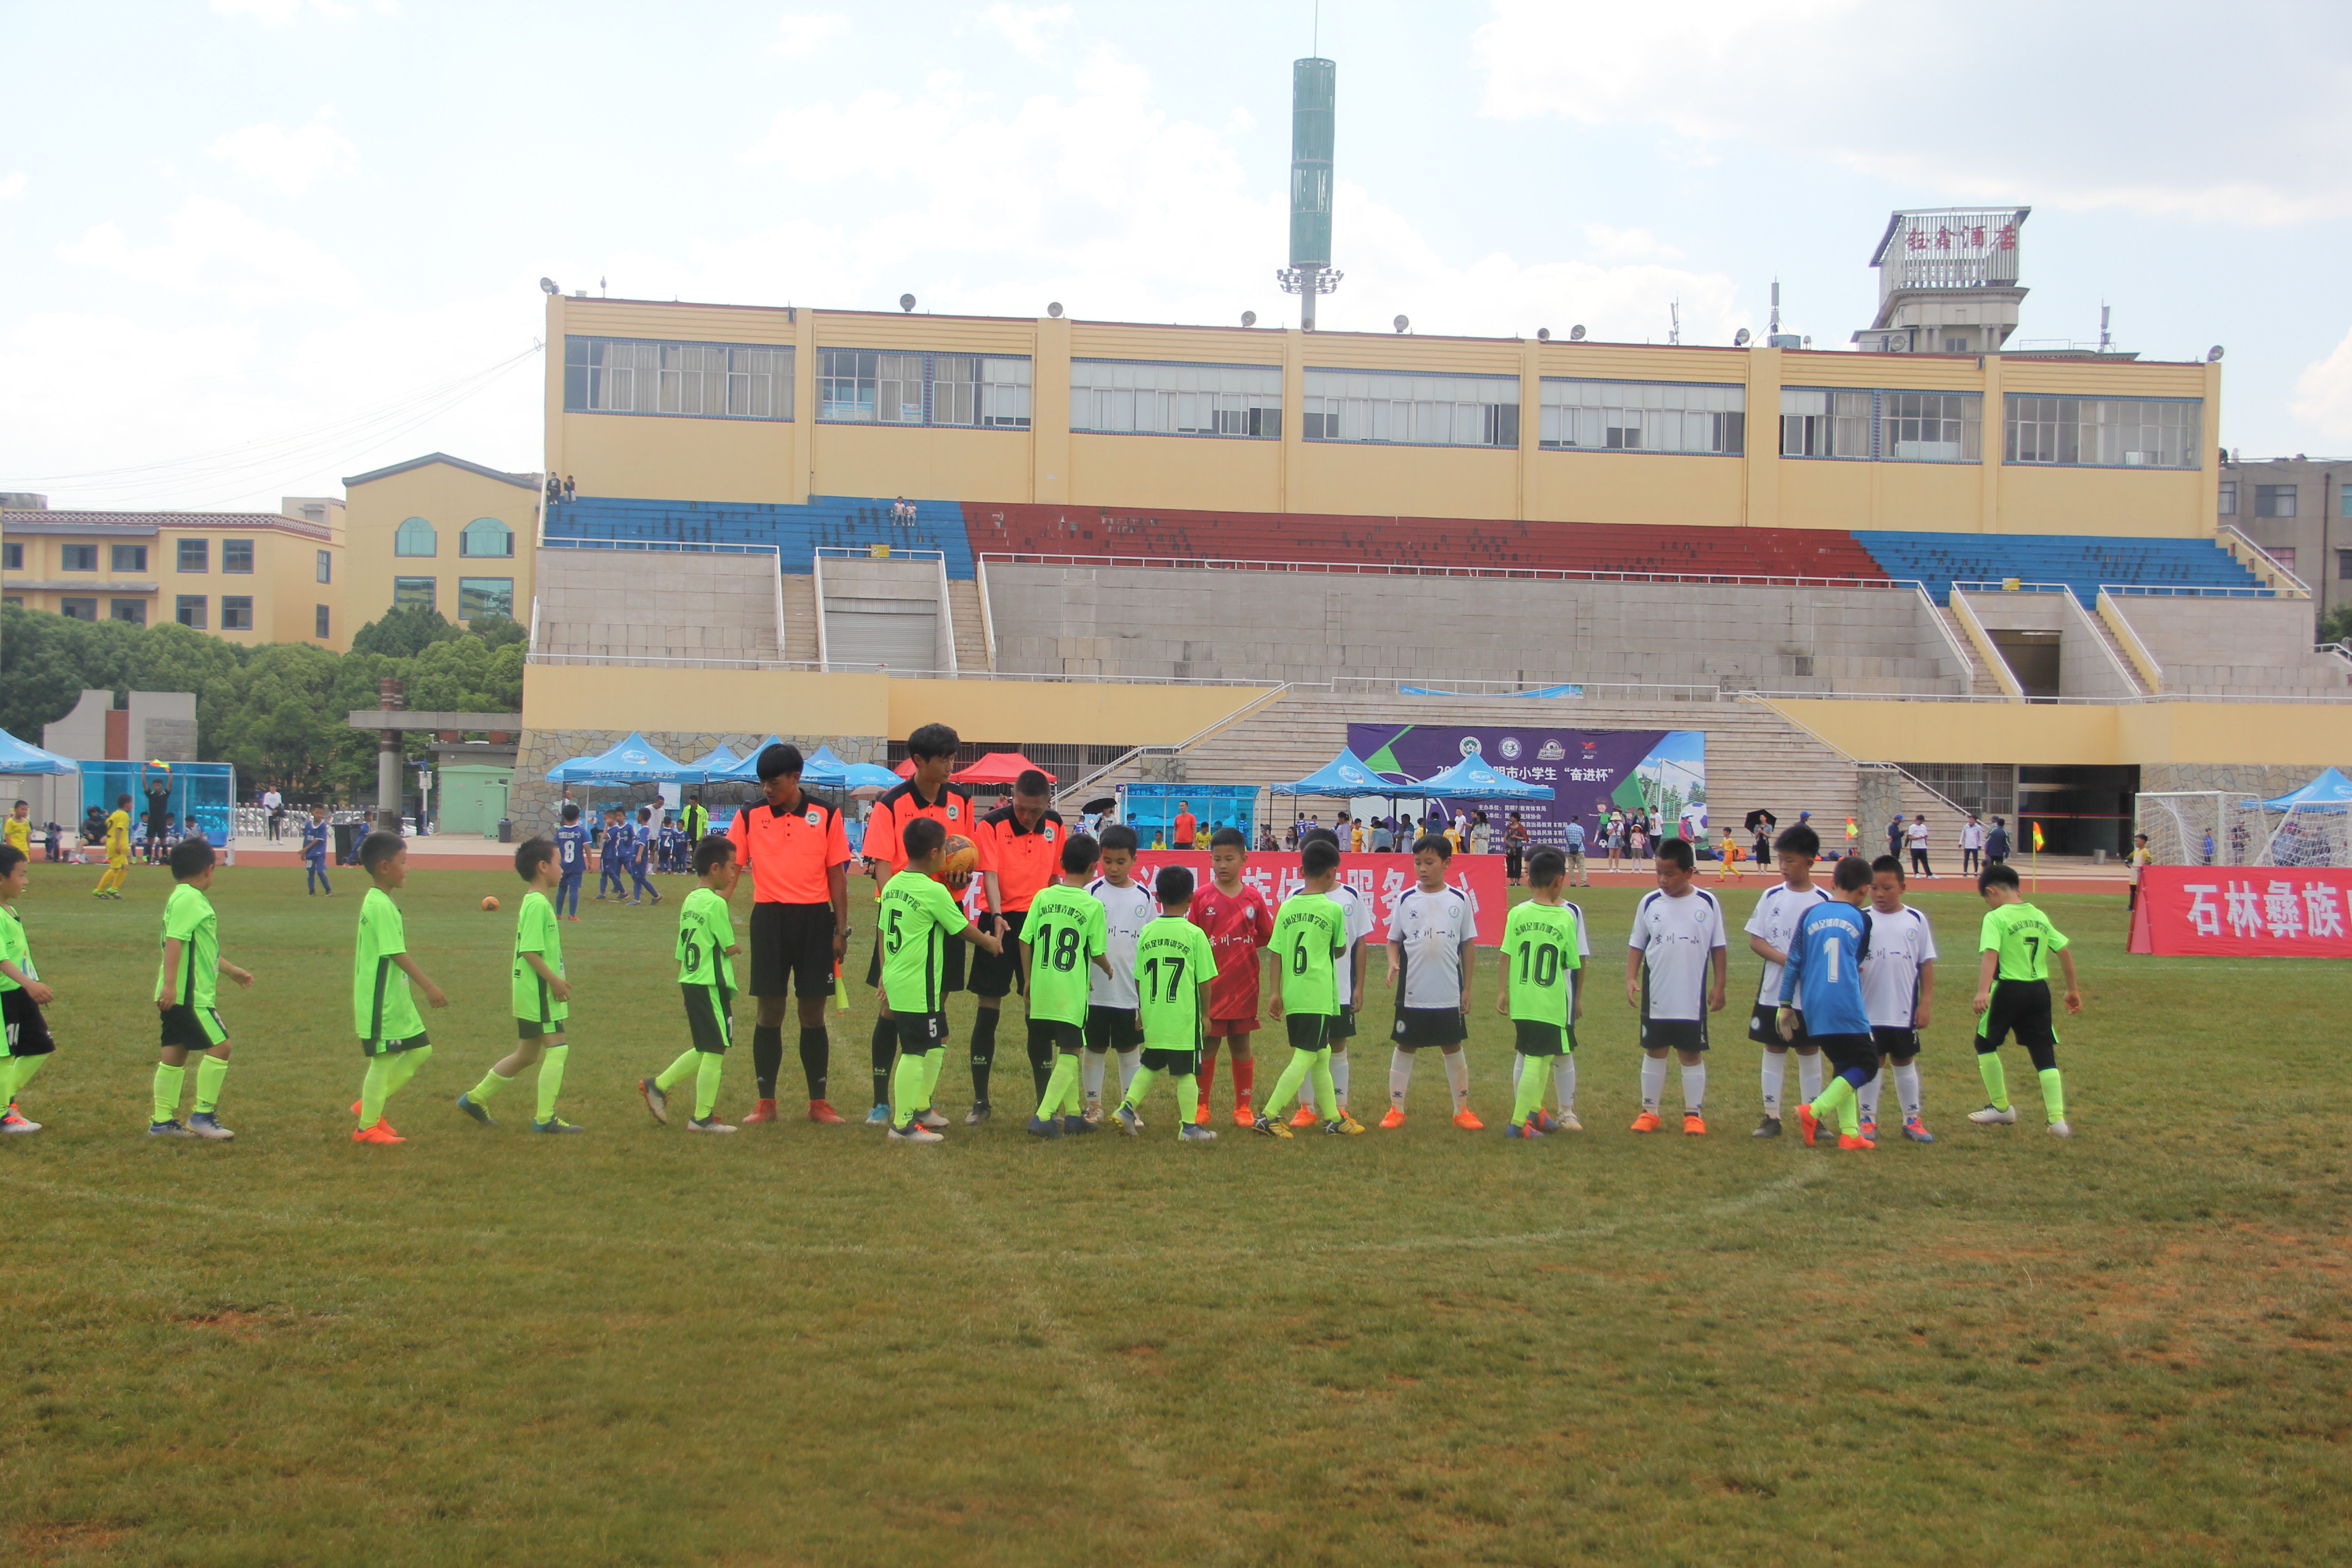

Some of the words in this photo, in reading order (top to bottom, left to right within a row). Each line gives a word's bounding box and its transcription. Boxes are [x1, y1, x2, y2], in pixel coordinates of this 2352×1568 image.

[564, 840, 575, 863] 8
[1108, 926, 1140, 938] 川一小
[2183, 880, 2352, 938] 石林彝族
[887, 909, 903, 956] 5
[1037, 923, 1080, 972] 18
[1293, 931, 1307, 977] 6
[1518, 941, 1558, 988] 10
[1823, 937, 1840, 983] 1
[2023, 936, 2039, 978] 7
[1144, 957, 1185, 1004] 17
[928, 1018, 938, 1038] 5
